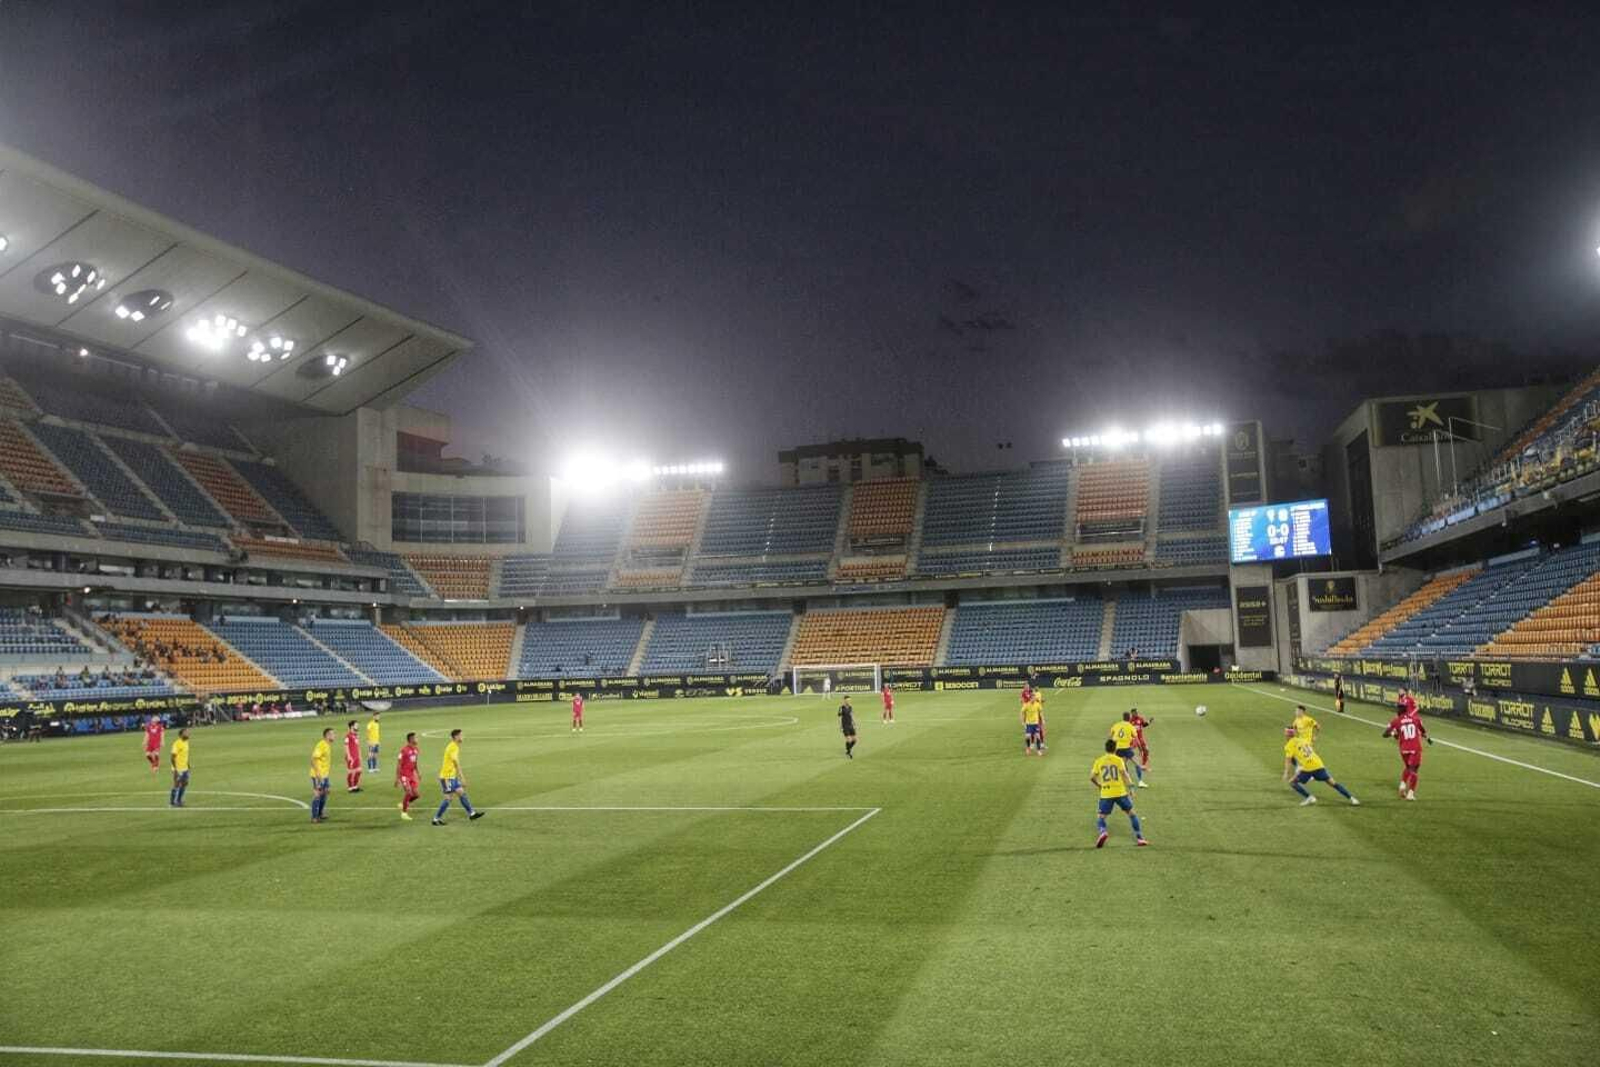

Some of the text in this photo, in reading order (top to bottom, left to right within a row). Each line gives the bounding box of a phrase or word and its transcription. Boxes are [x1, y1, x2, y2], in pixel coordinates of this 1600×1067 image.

[1480, 663, 1512, 677] TORROT
[1498, 700, 1535, 718] TORROT
[1400, 723, 1416, 740] 10
[1101, 764, 1119, 782] 20
